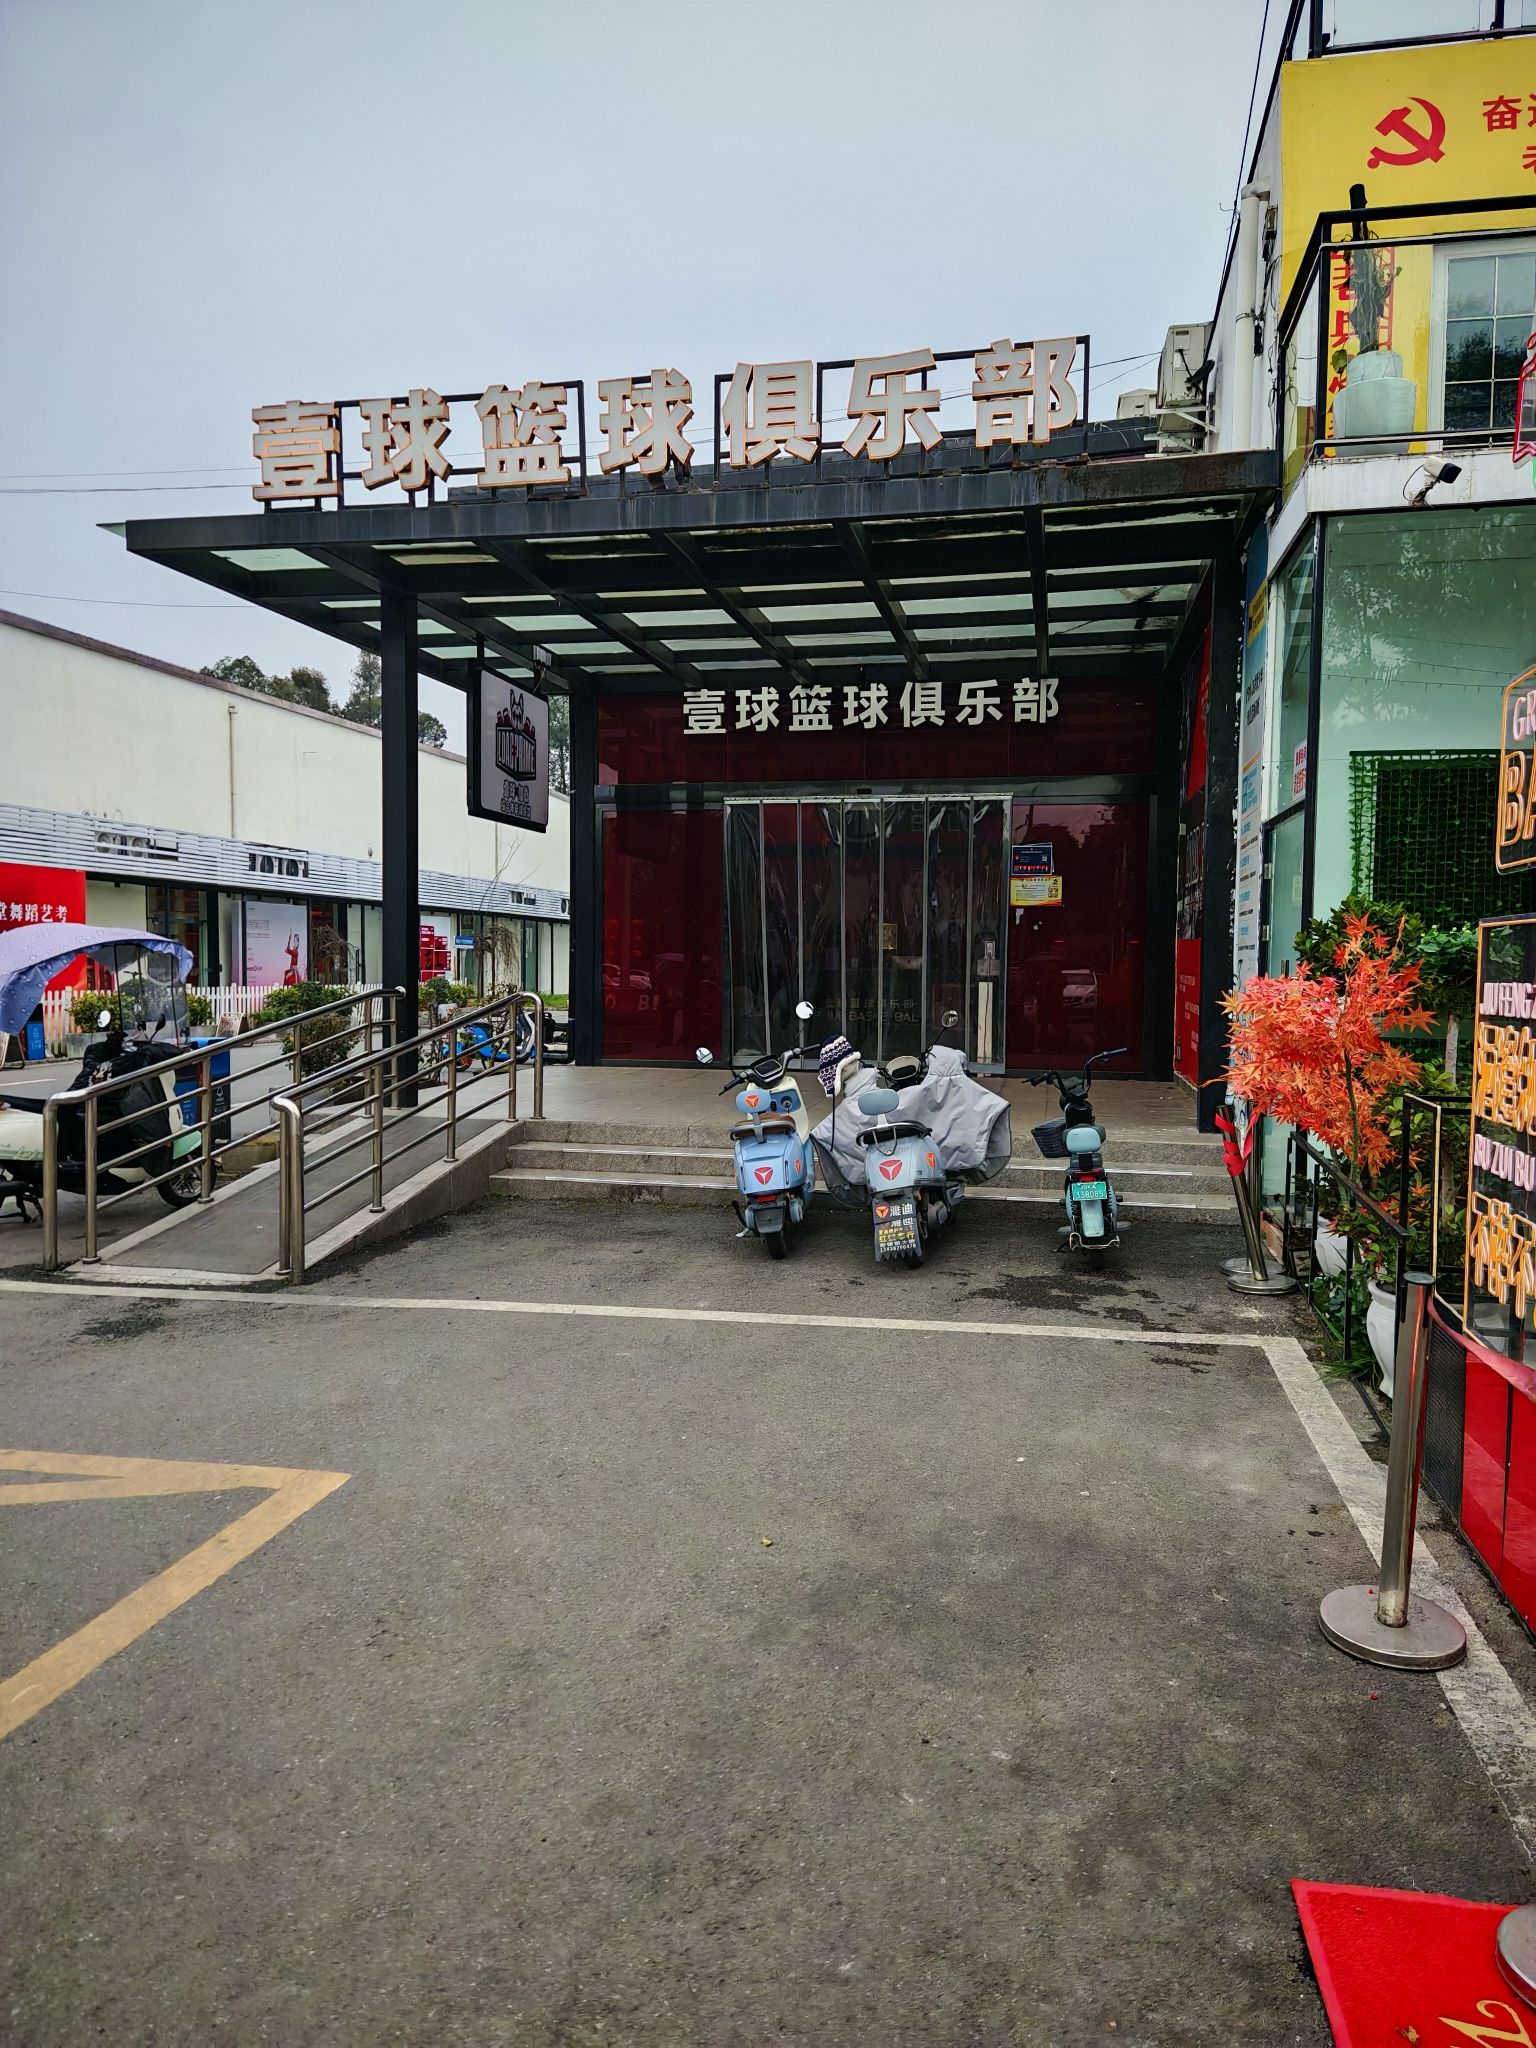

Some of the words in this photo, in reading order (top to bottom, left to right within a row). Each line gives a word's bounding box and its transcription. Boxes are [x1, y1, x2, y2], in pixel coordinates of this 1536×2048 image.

[1482, 93, 1536, 132] 奋
[251, 336, 1079, 502] 壹球篮球俱乐部
[682, 677, 1060, 735] 壹球篮球俱乐部
